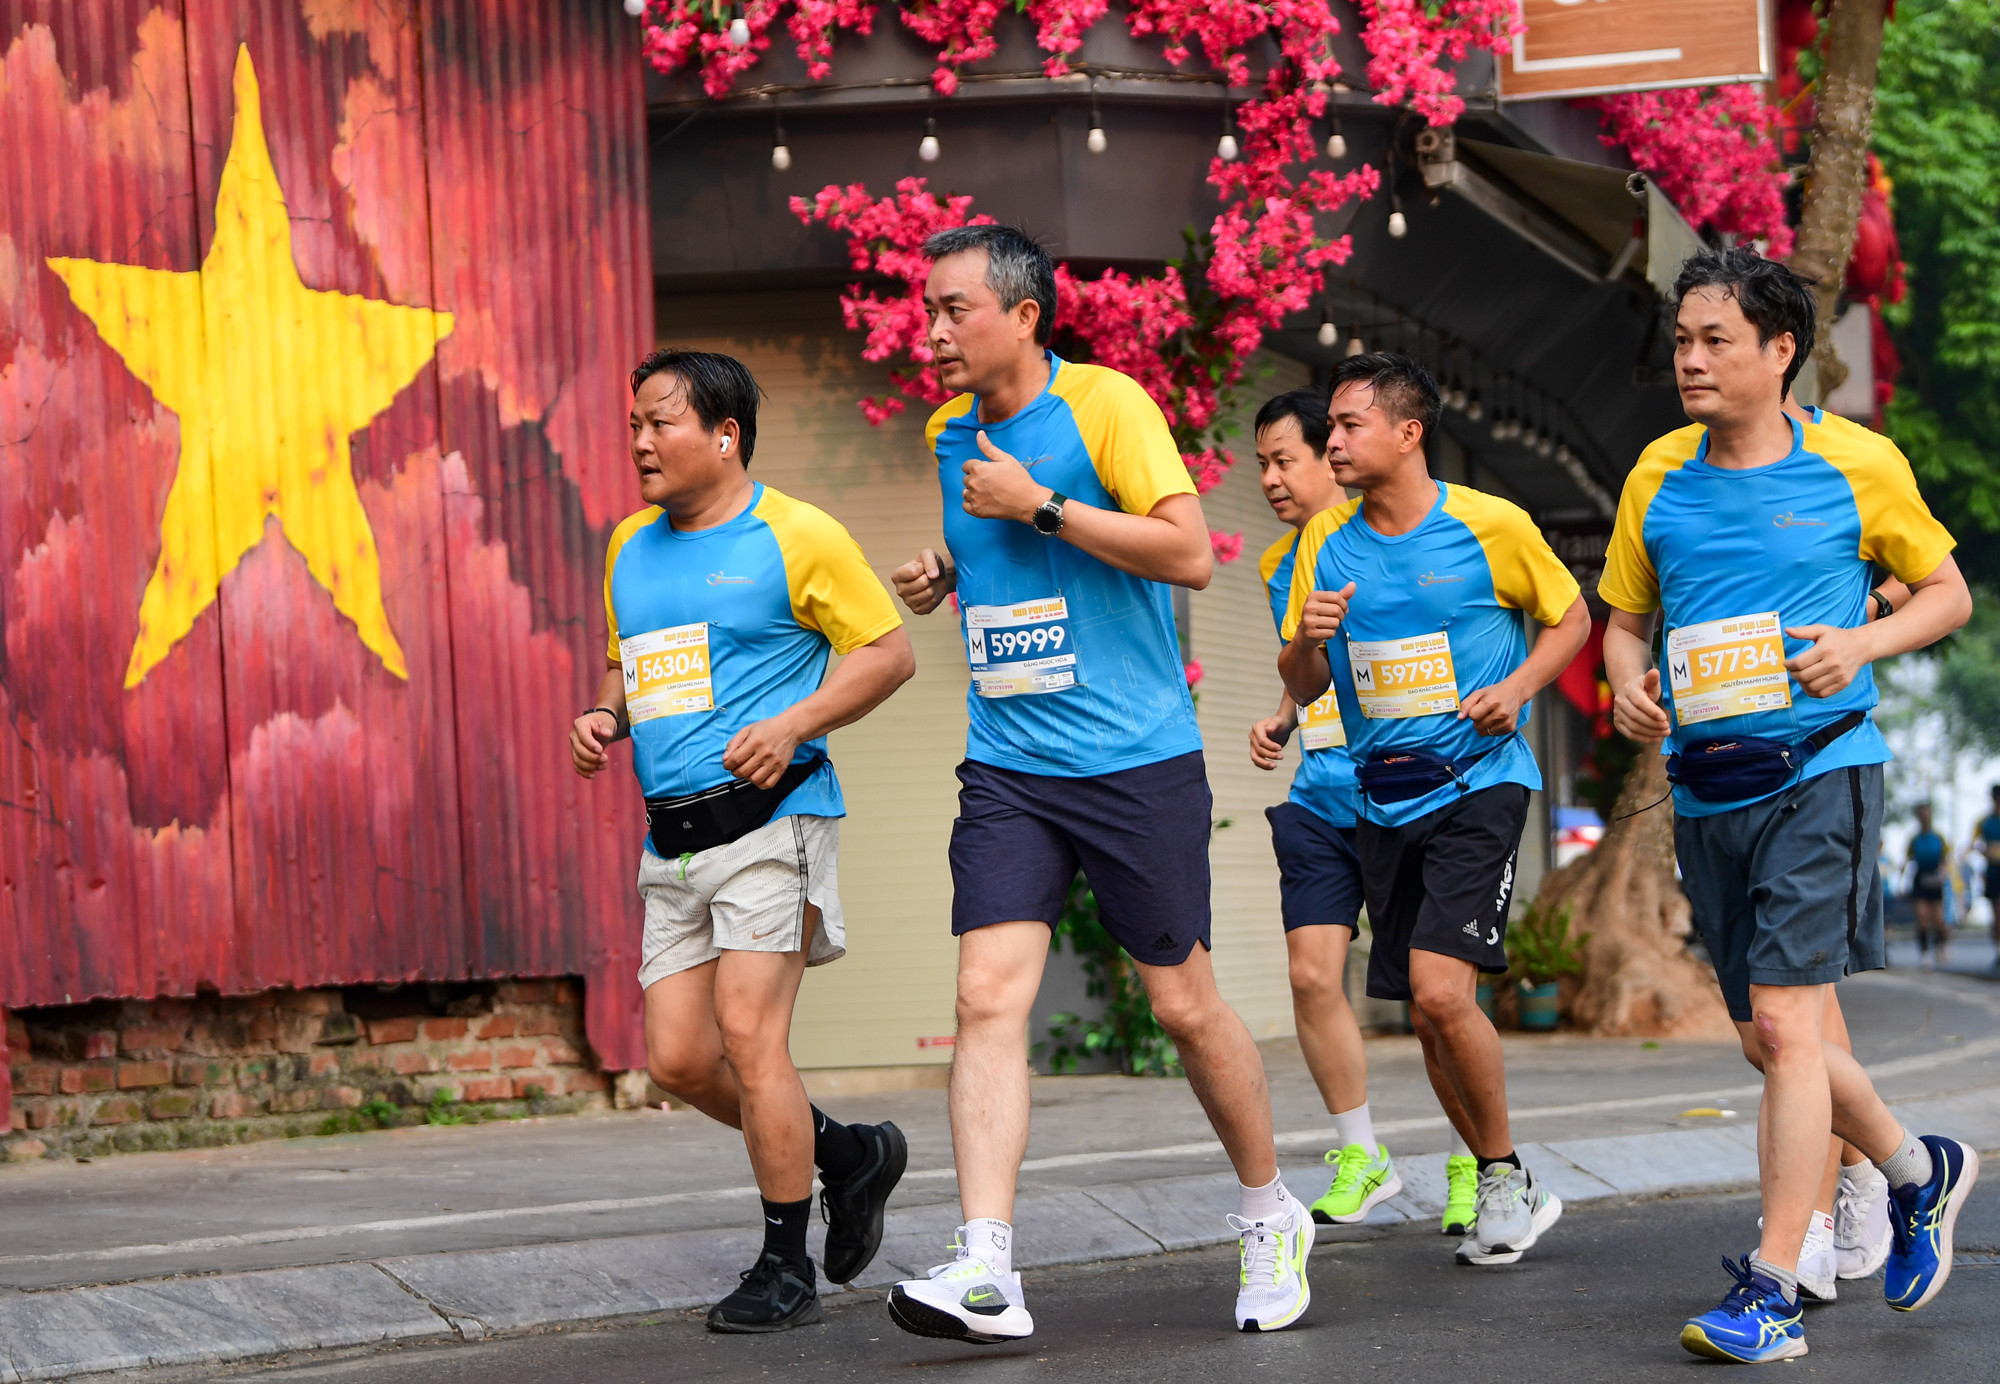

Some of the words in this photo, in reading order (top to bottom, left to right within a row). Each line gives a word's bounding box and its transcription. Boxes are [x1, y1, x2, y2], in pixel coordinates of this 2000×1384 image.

[972, 638, 982, 654] M
[991, 625, 1065, 657] 59999
[626, 669, 636, 685] M
[642, 651, 704, 682] 56304
[1356, 668, 1370, 683] M
[1381, 658, 1449, 685] 59793
[1674, 662, 1687, 680] M
[1698, 643, 1778, 678] 57734
